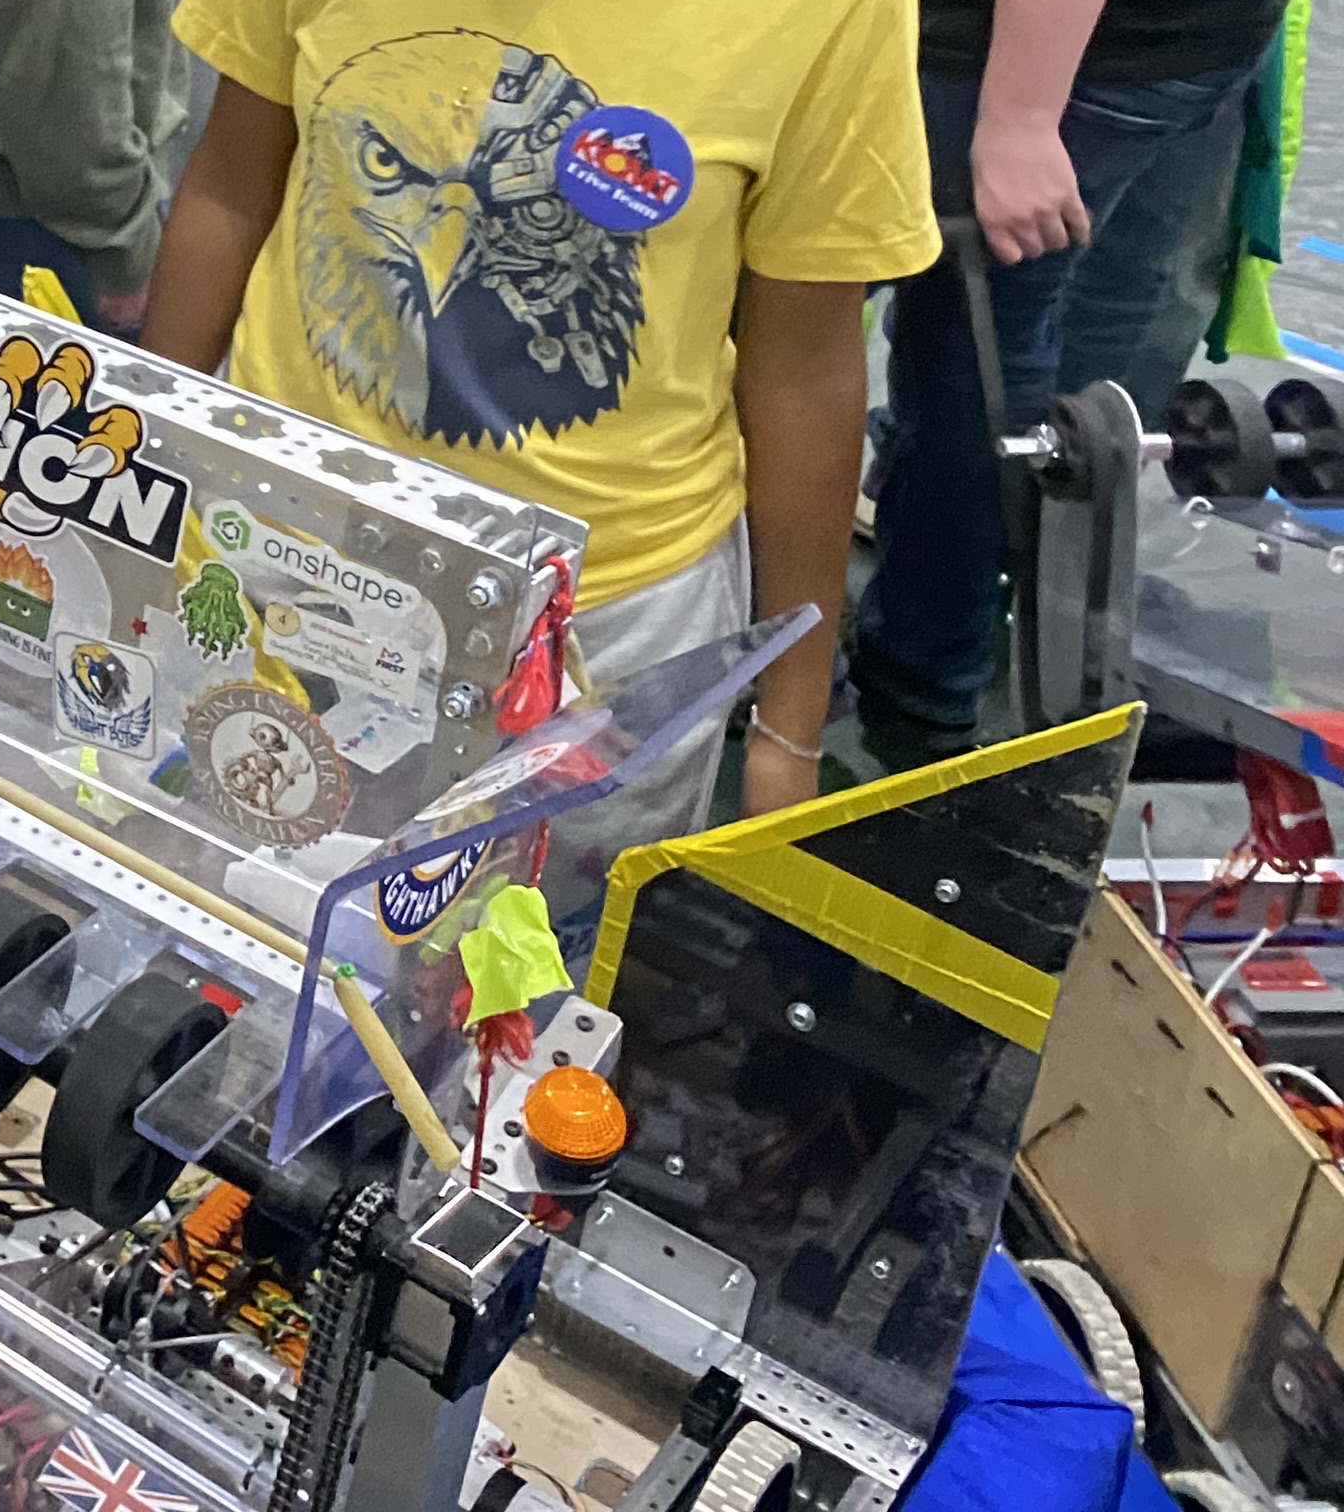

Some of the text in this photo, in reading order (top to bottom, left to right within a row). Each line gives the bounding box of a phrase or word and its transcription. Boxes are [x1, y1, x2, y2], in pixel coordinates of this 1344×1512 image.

[263, 538, 404, 610] onshape
[22, 636, 32, 654] IS
[32, 646, 53, 665] FINE
[375, 658, 406, 675] FIRST
